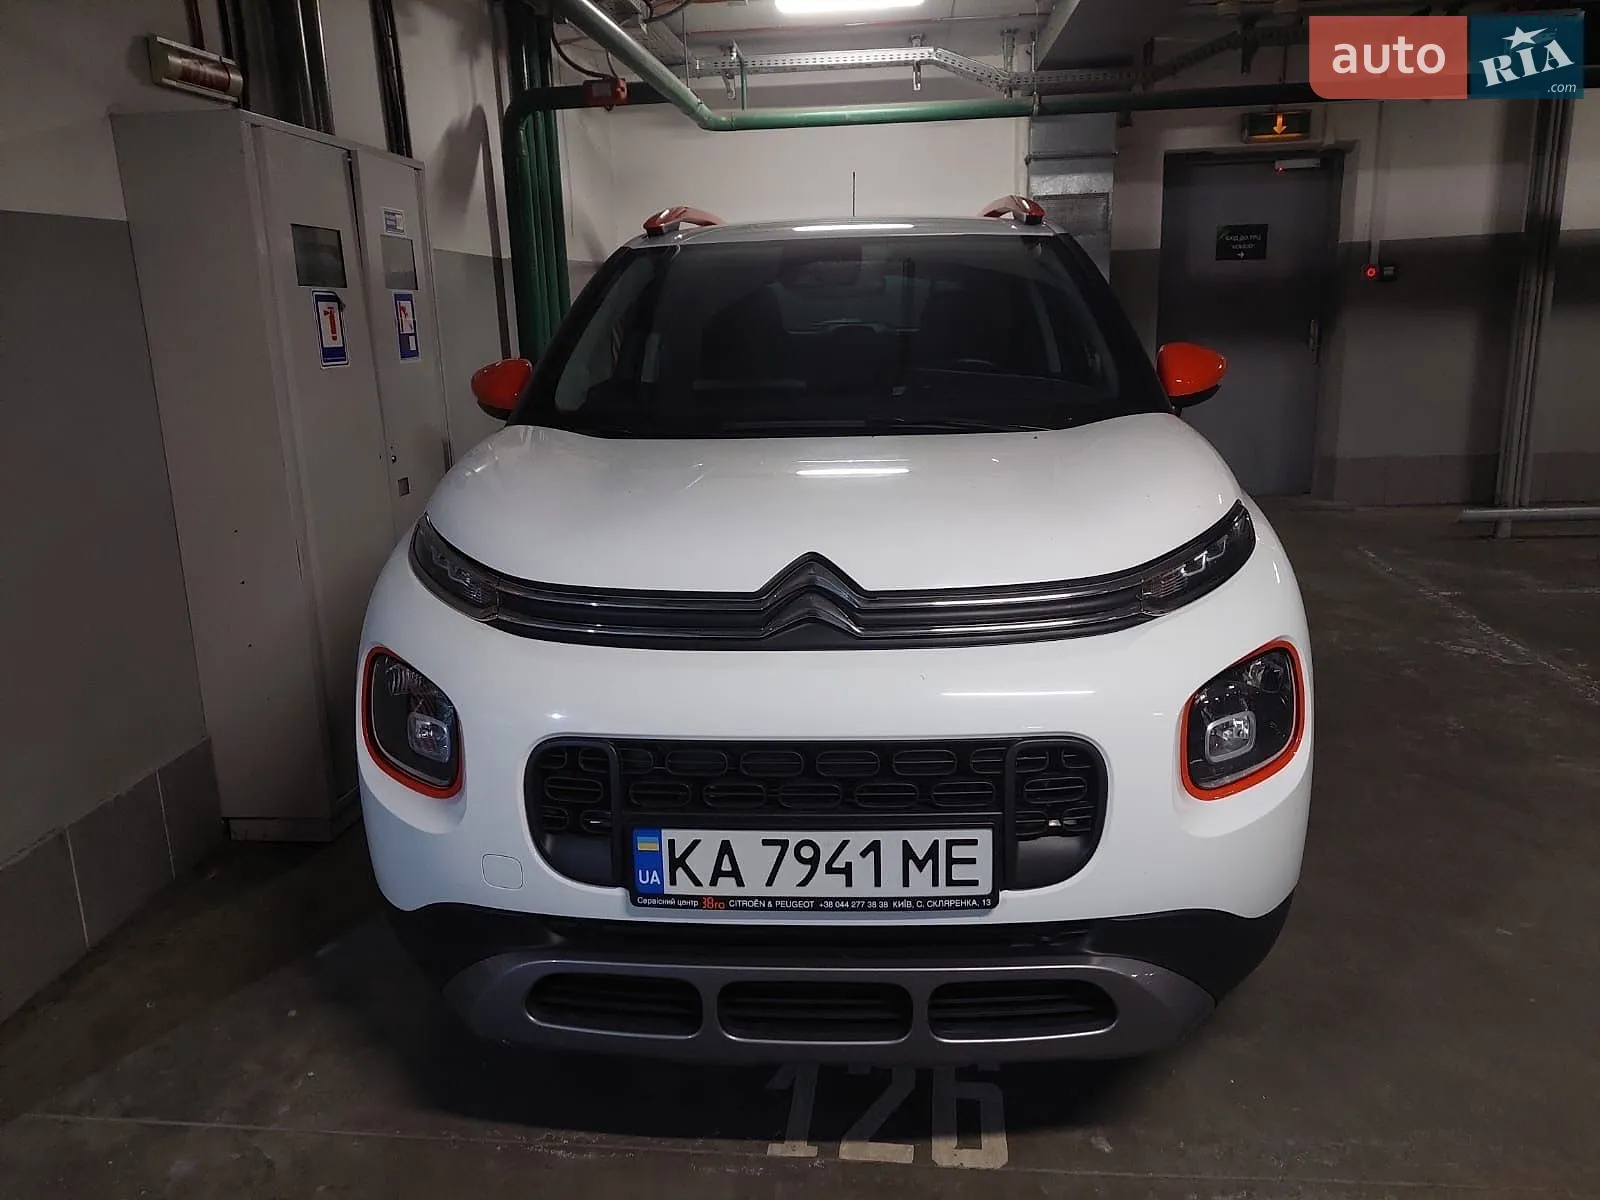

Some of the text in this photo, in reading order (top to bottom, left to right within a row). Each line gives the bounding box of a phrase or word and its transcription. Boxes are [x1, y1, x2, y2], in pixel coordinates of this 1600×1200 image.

[667, 838, 980, 887] KA 7941 ME
[638, 869, 661, 885] UA
[677, 899, 699, 908] центр
[775, 900, 814, 909] PEUGEOT
[819, 900, 833, 909] +38
[834, 900, 849, 909] 044
[850, 900, 865, 909] 277
[867, 900, 877, 909] 38
[878, 900, 889, 909] 38
[892, 899, 915, 909] КИЇВ,
[926, 898, 980, 908] СКЛЯРЕНКА,
[982, 898, 991, 906] 13
[765, 1063, 1008, 1169] 126
